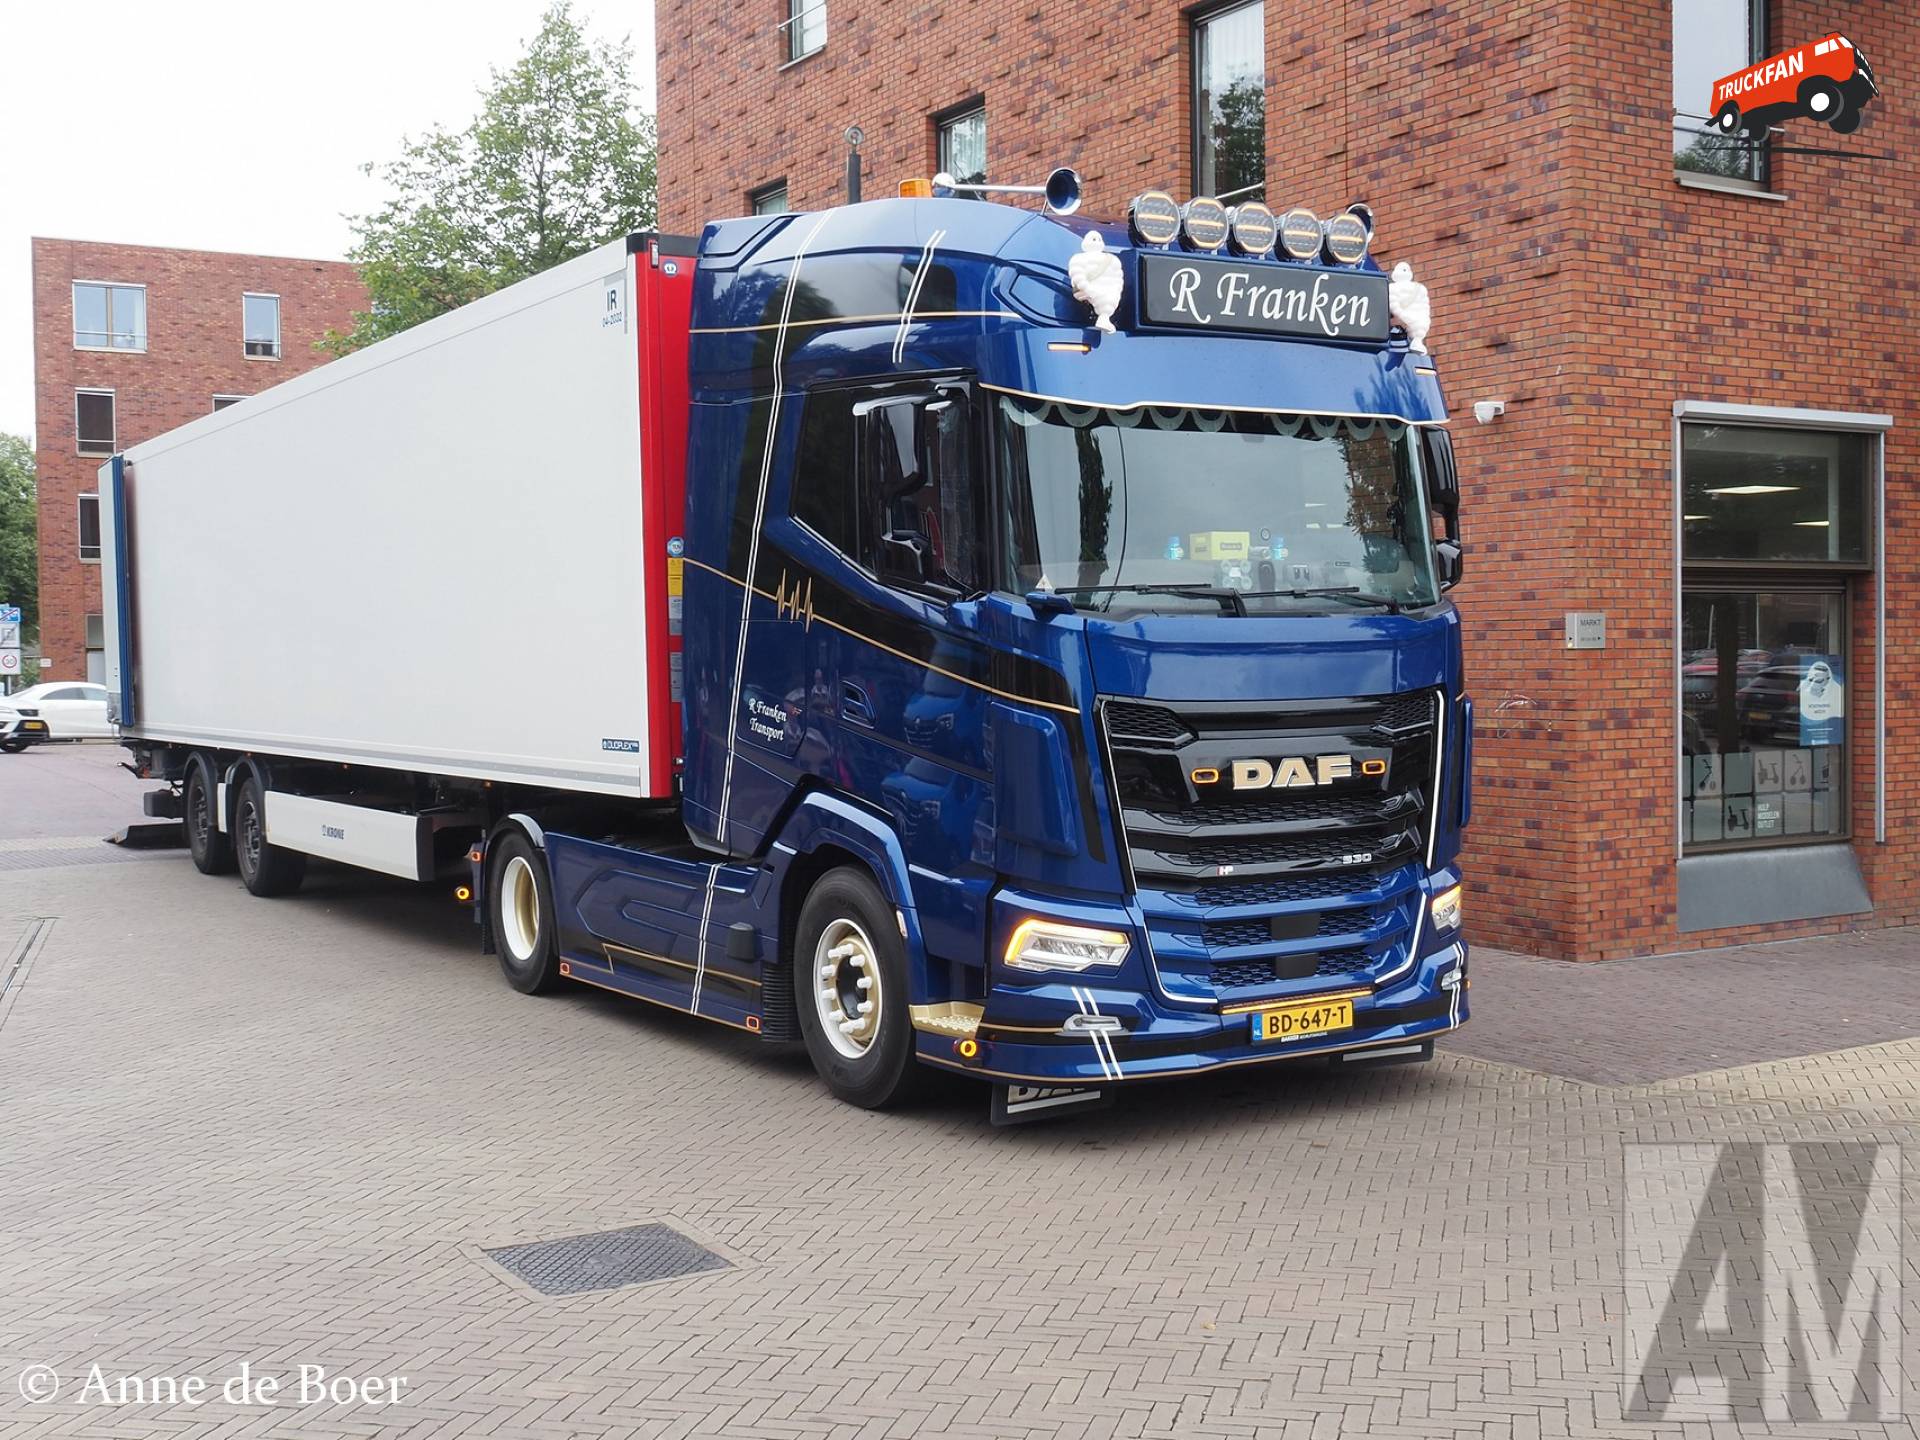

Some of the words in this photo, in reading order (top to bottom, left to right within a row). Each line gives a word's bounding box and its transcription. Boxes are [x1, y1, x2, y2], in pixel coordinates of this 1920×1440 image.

[606, 289, 617, 312] IR
[1169, 267, 1211, 324] R
[1217, 273, 1371, 336] Franken
[756, 700, 787, 723] Franken
[749, 717, 784, 742] Transport
[1231, 754, 1353, 791] DAF
[1269, 1006, 1346, 1034] BD-647-T
